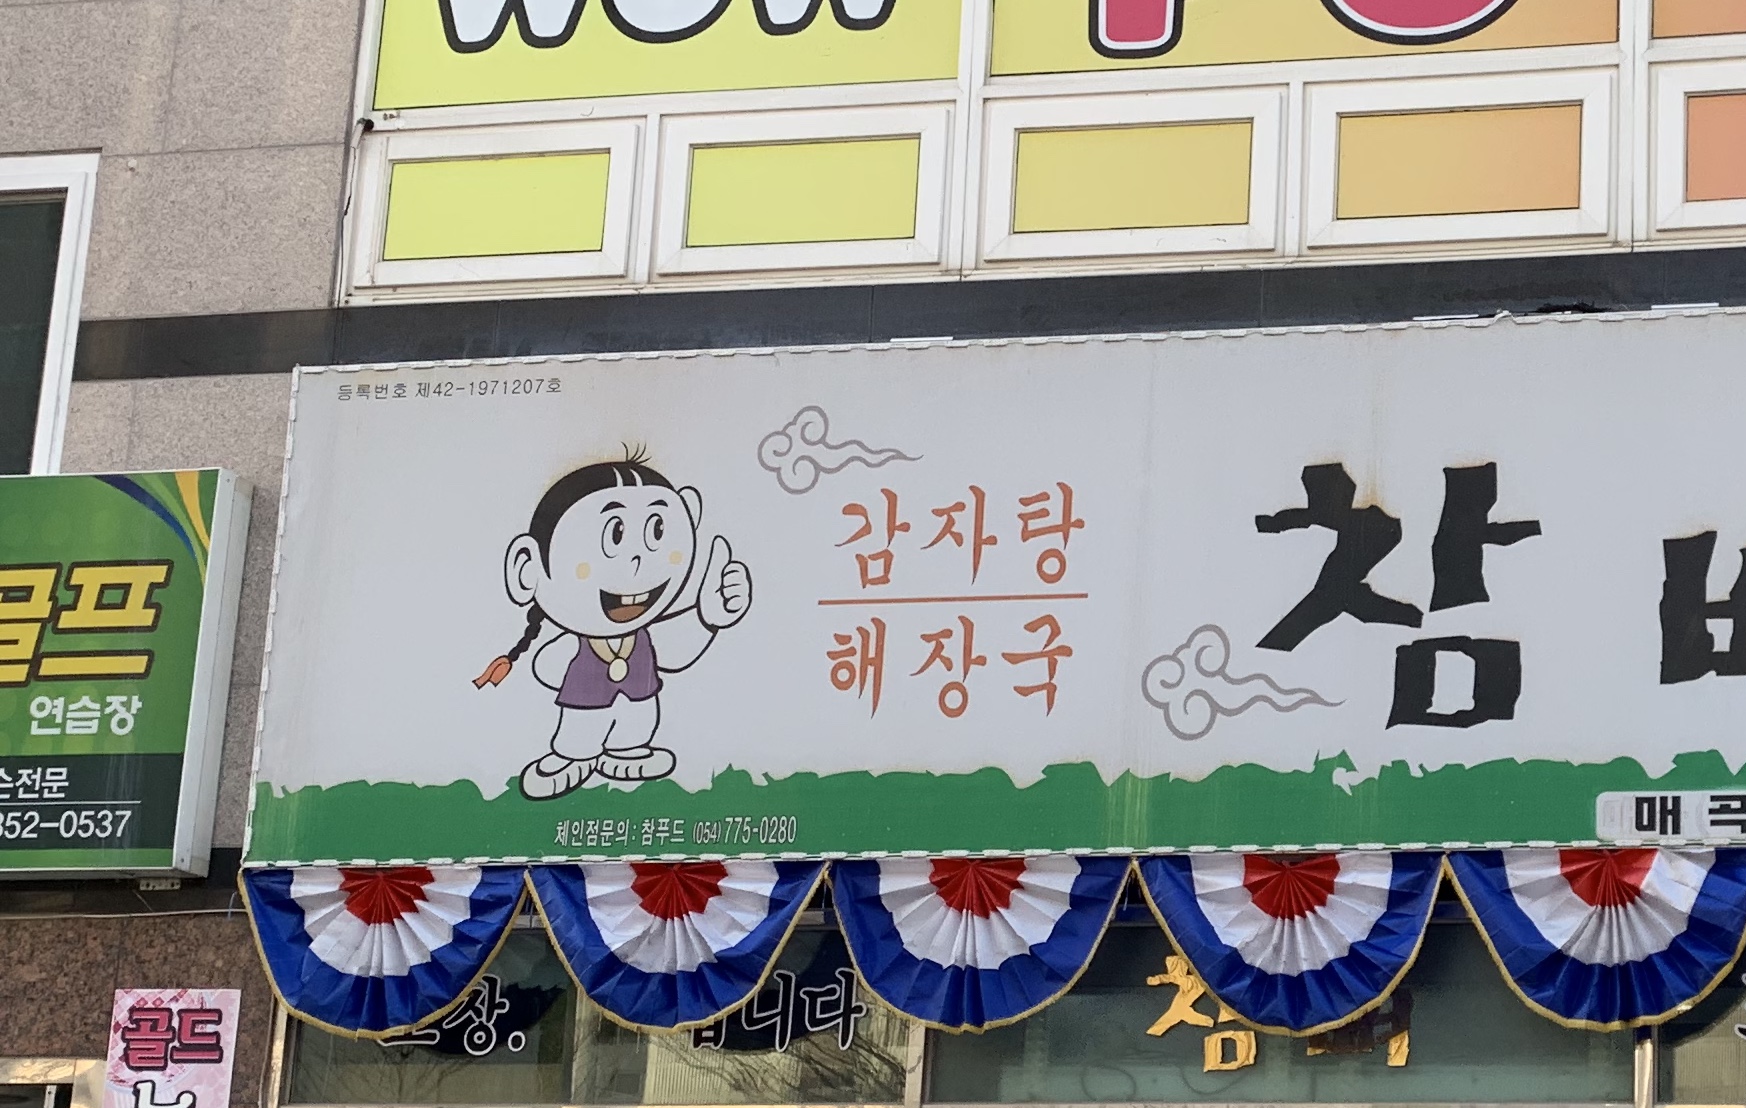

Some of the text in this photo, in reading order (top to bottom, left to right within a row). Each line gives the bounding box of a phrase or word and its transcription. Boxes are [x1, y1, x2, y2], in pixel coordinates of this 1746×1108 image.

[337, 377, 562, 401] 등록번호 제42-1971207호
[835, 482, 1086, 589] 감자탕
[826, 614, 1073, 719] 해장국
[30, 695, 142, 736] 연습장
[0, 809, 132, 840] 52-0537
[641, 818, 685, 846] 참푸드
[123, 1006, 224, 1071] 골드
[378, 973, 526, 1056] 장.
